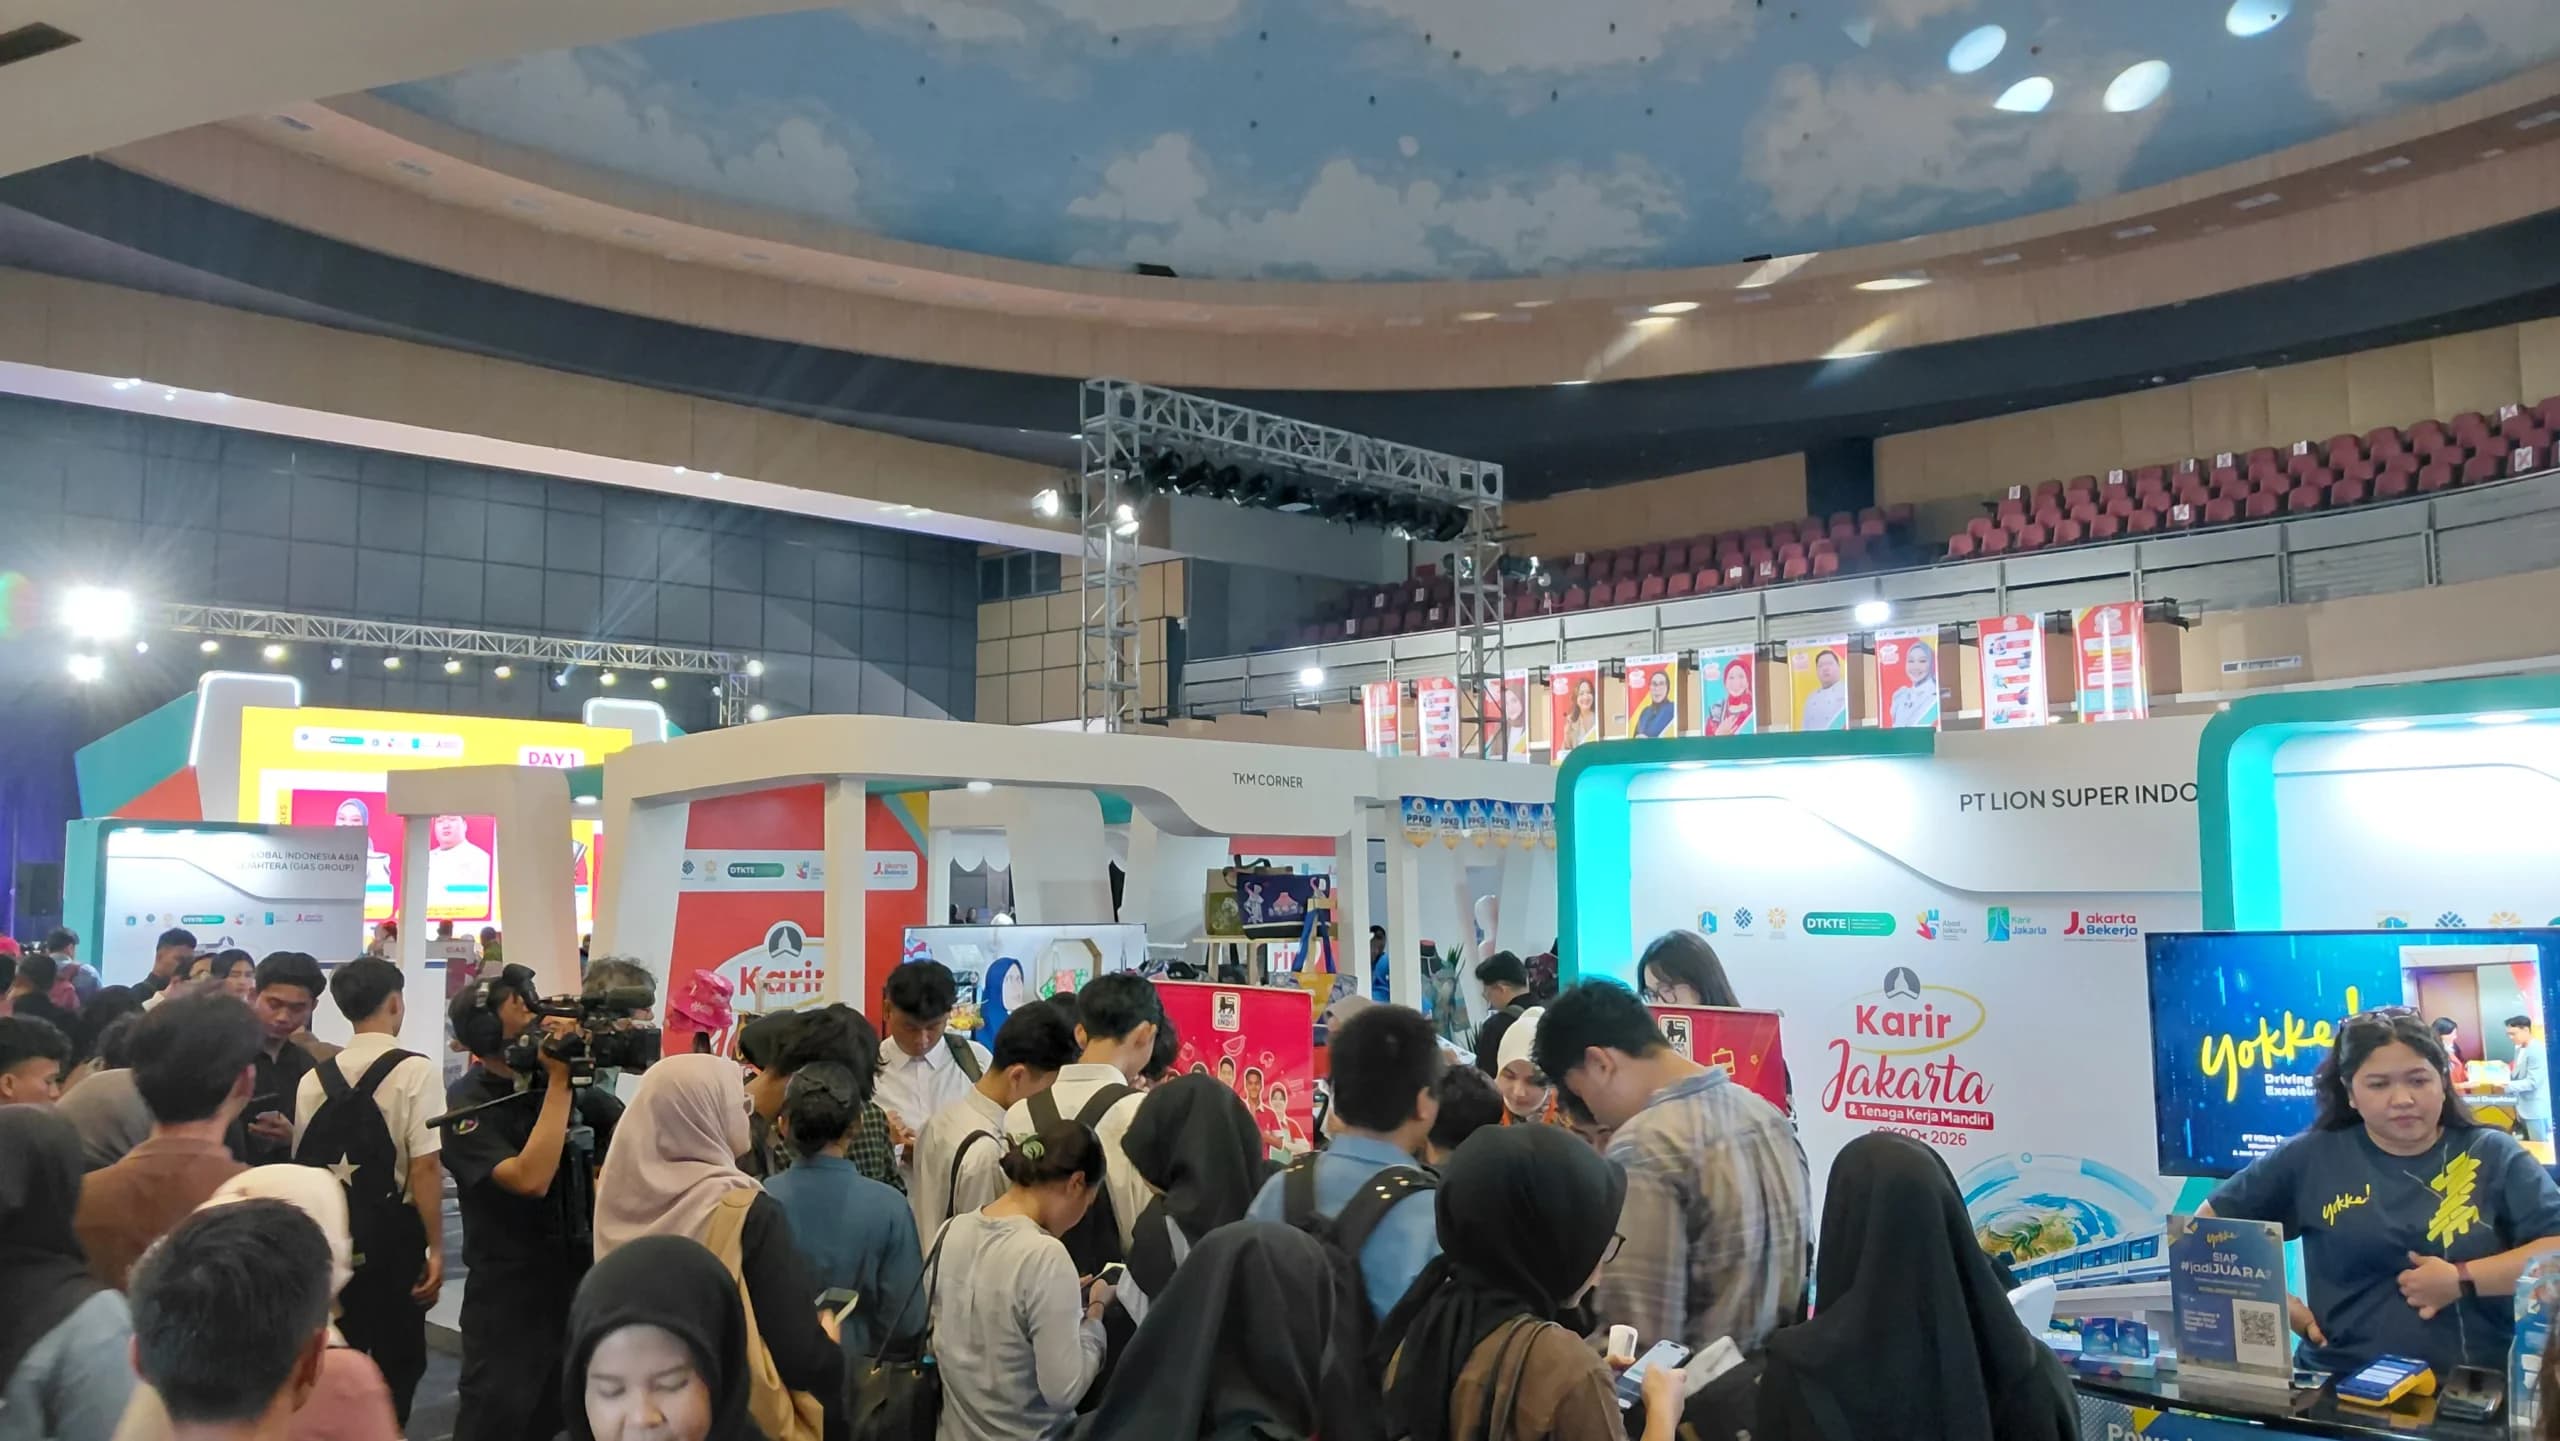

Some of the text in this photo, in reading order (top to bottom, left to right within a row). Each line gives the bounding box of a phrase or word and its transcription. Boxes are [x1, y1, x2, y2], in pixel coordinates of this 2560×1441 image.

[528, 752, 575, 768] DAY 1
[1232, 772, 1304, 789] TKM CORNER
[1959, 782, 2198, 812] PT LION SUPER INDO
[1406, 813, 1432, 825] PPKD
[285, 852, 337, 860] INDONESIA
[339, 853, 359, 861] ASIA
[729, 866, 755, 875] DTKTE
[1807, 917, 1847, 929] DTKTE
[2012, 926, 2047, 935] Jakarta
[2086, 925, 2138, 937] Bekerja
[1856, 1003, 1952, 1039] Karir
[1822, 1038, 1994, 1112] Jakarta
[2264, 1073, 2314, 1087] Driving
[1848, 1103, 1990, 1126] & Tenaga Kerja Mandiri
[1930, 1129, 1967, 1147] 2026
[2212, 1251, 2239, 1264] SIAP
